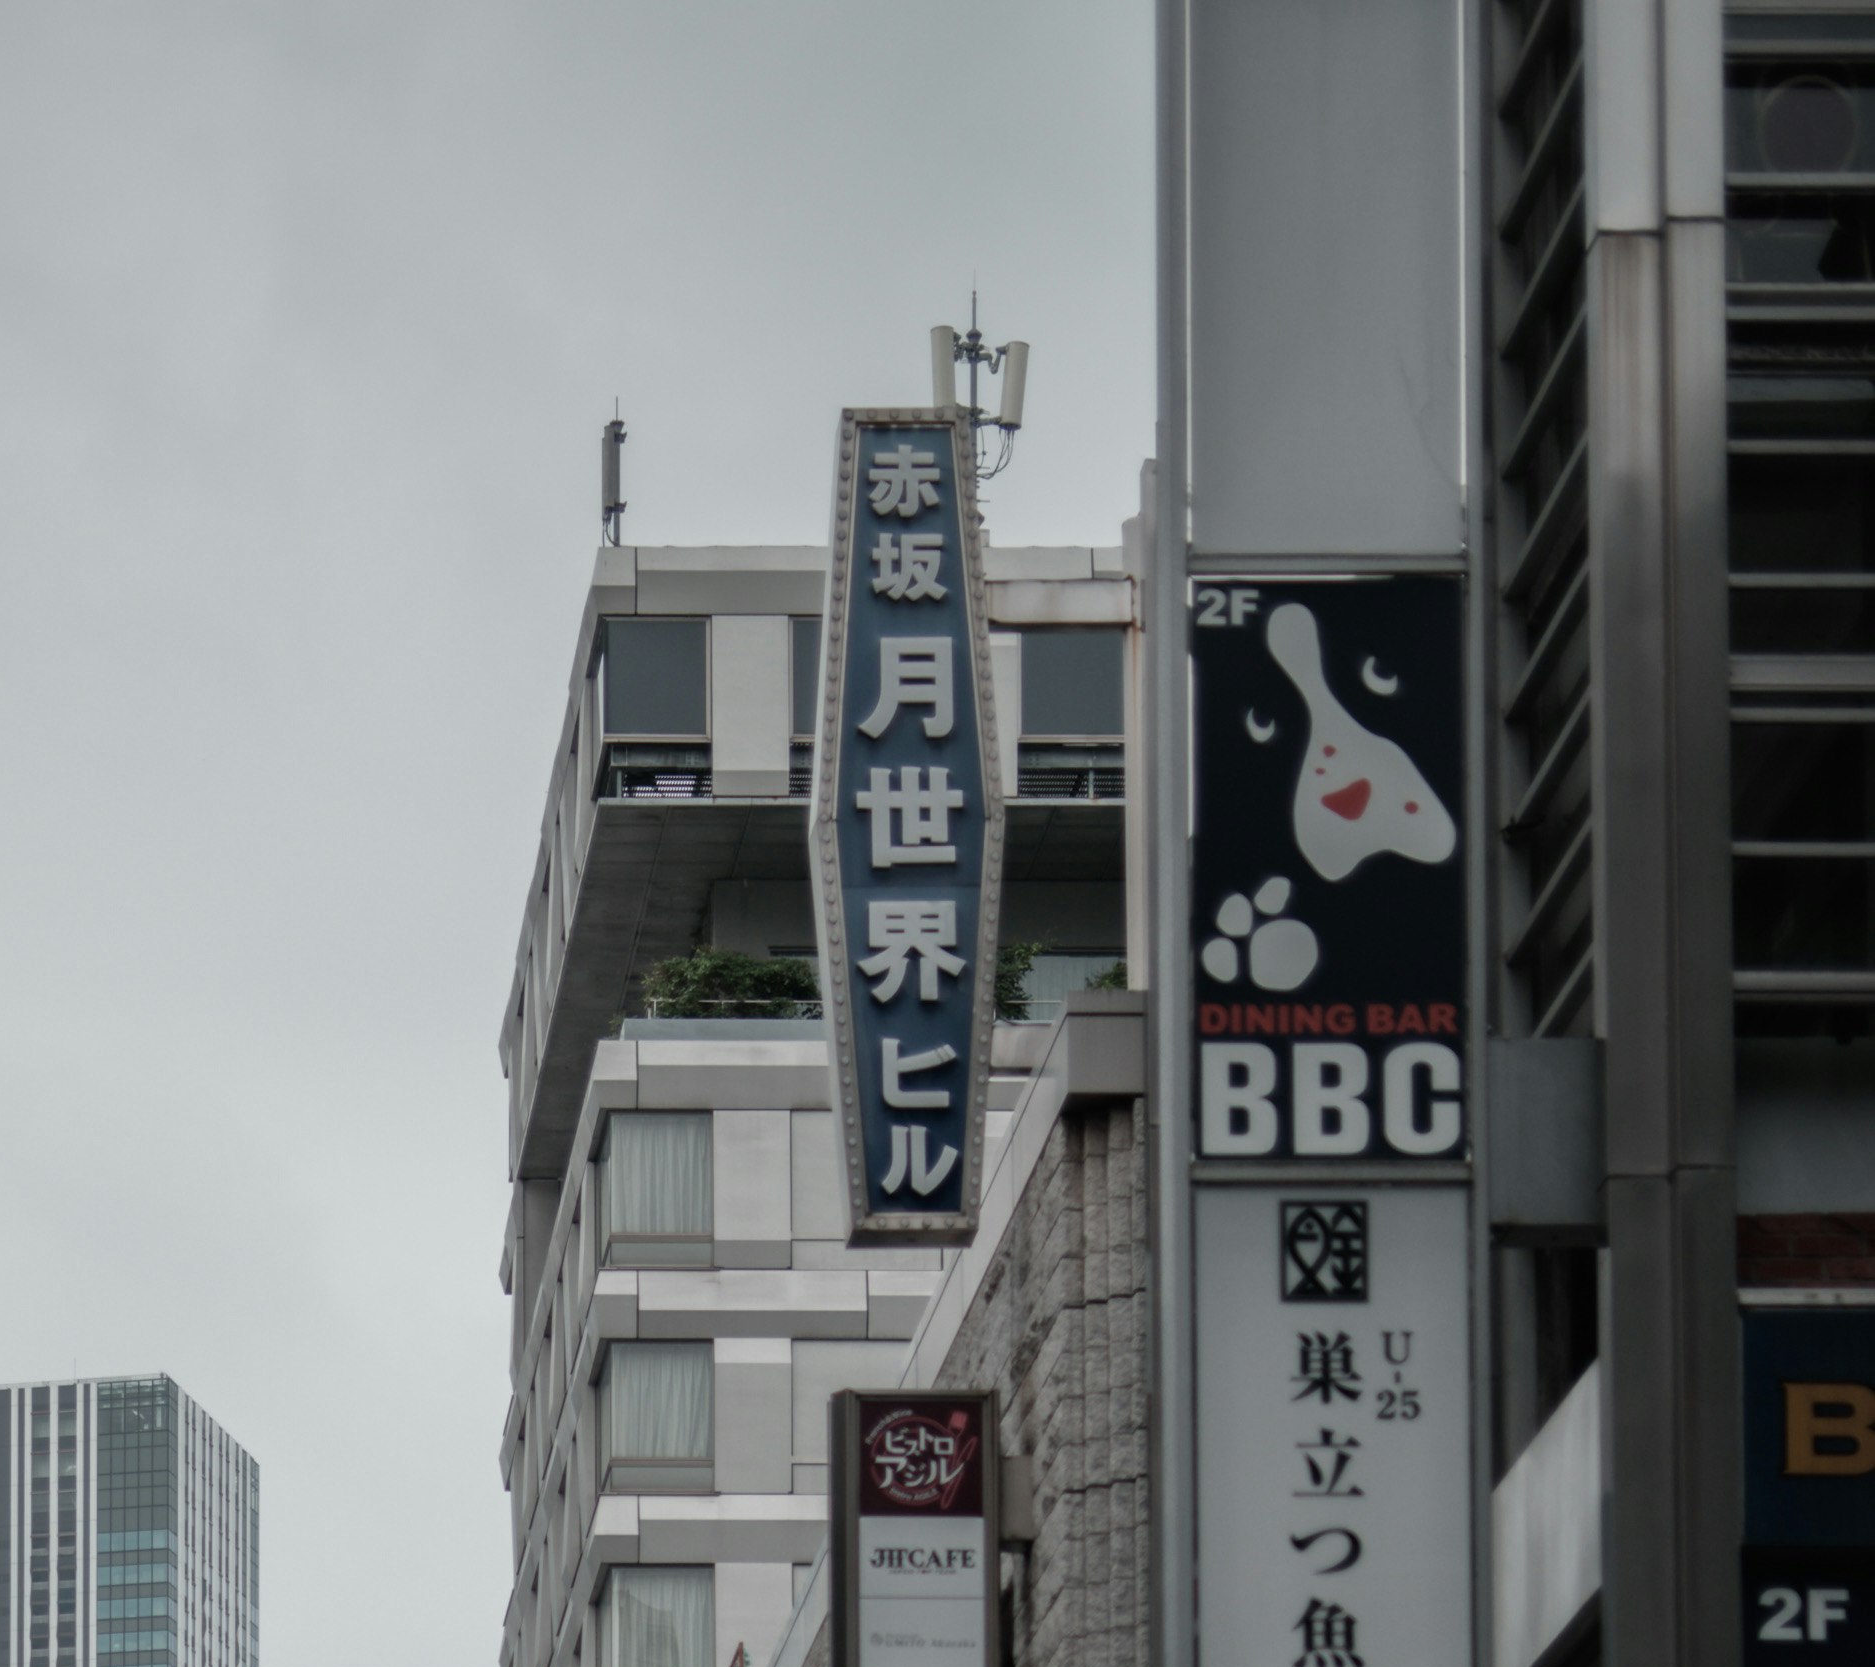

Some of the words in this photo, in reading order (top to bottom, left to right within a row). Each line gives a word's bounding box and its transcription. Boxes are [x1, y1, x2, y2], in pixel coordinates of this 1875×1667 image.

[1196, 589, 1259, 627] 2F
[856, 444, 966, 1198] 赤坂月世界ビル
[1200, 1003, 1356, 1033] DINING
[1366, 1003, 1458, 1033] BAR
[1201, 1042, 1461, 1155] BBC
[885, 1426, 954, 1456] ビストロ
[875, 1455, 966, 1489] アジル
[1757, 1588, 1851, 1641] 2F
